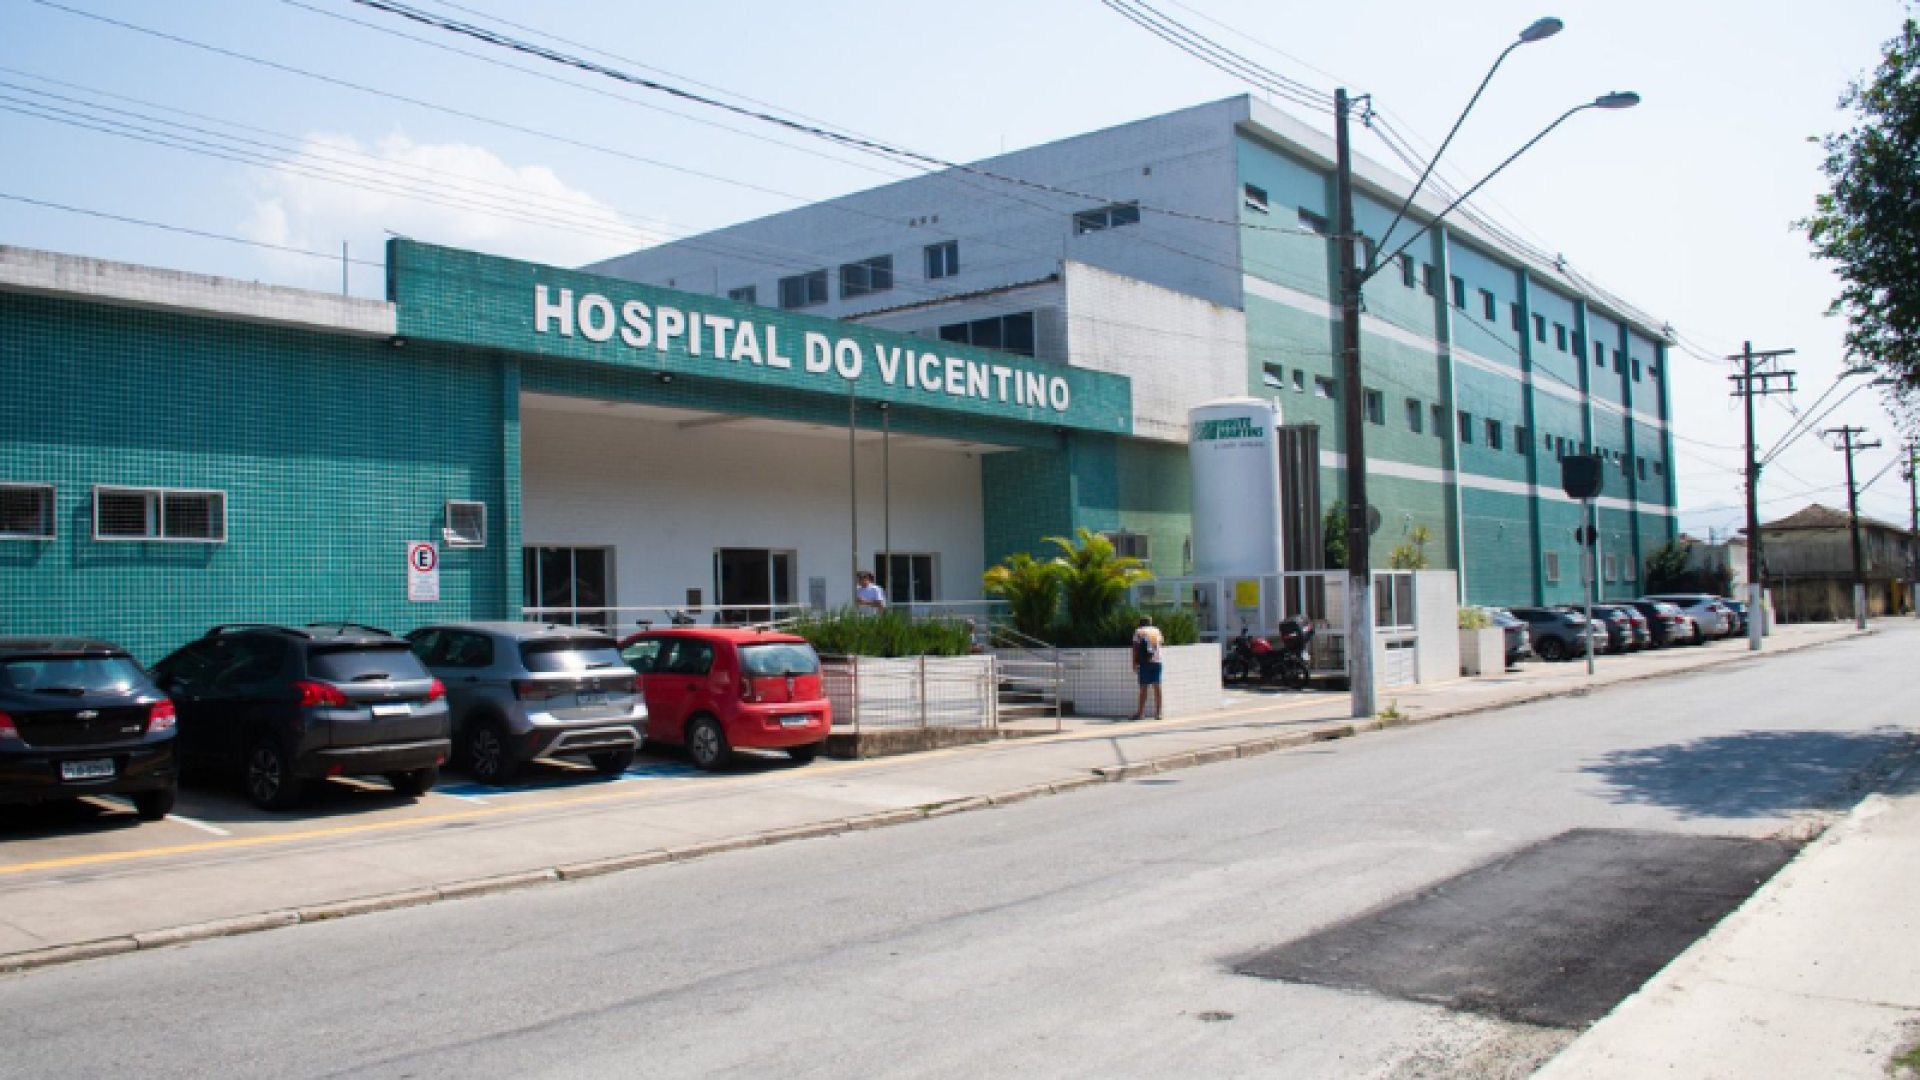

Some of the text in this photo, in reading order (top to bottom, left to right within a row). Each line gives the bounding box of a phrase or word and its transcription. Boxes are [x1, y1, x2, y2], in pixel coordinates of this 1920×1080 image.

[534, 284, 1070, 412] HOSPITAL DO VICENTINO
[418, 549, 428, 567] E
